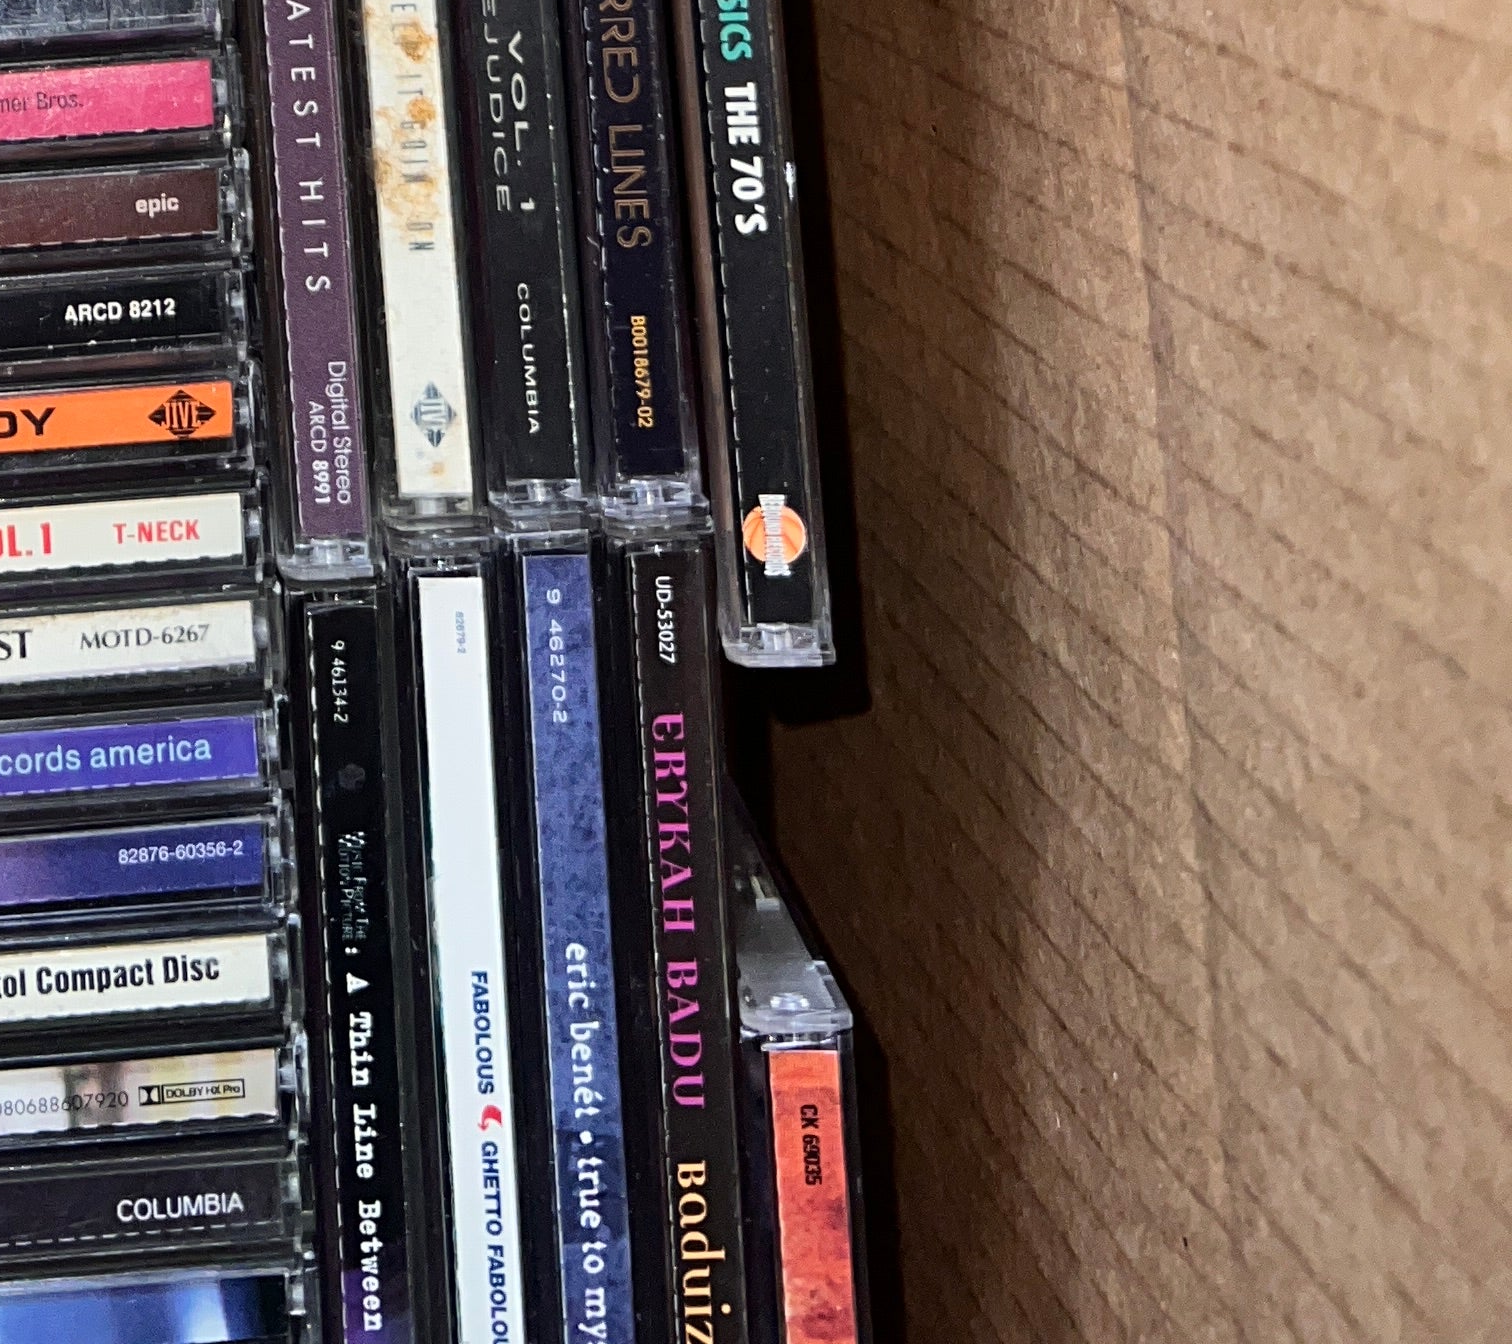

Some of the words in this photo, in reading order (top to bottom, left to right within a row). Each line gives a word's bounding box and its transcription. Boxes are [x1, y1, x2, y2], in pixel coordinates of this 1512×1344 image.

[509, 31, 532, 167] VOL.
[723, 82, 760, 147] THE
[136, 195, 179, 218] epic
[608, 123, 651, 249] LINES
[732, 157, 768, 235] 70'S
[298, 180, 330, 293] HITS
[129, 298, 175, 319] 8212
[515, 282, 541, 435] COLUMBIA
[308, 401, 327, 451] ARCD
[327, 361, 348, 432] Digital
[315, 461, 330, 505] 8991
[333, 435, 352, 504] Stereo
[331, 655, 348, 724] 46134-2
[549, 619, 568, 725] 46270-2
[90, 735, 211, 769] america
[118, 840, 243, 865] 82876-60356-2
[36, 961, 154, 995] Compact
[162, 955, 220, 984] Disc
[565, 942, 589, 1010] eric
[349, 1012, 374, 1088] Thin
[470, 970, 495, 1095] FABOLOUS
[662, 959, 706, 1109] BADU
[354, 1103, 374, 1181] Line
[800, 1104, 817, 1130] CK
[117, 1191, 243, 1223] COLUMBIA
[480, 1140, 503, 1237] GHETTO
[576, 1156, 601, 1230] true
